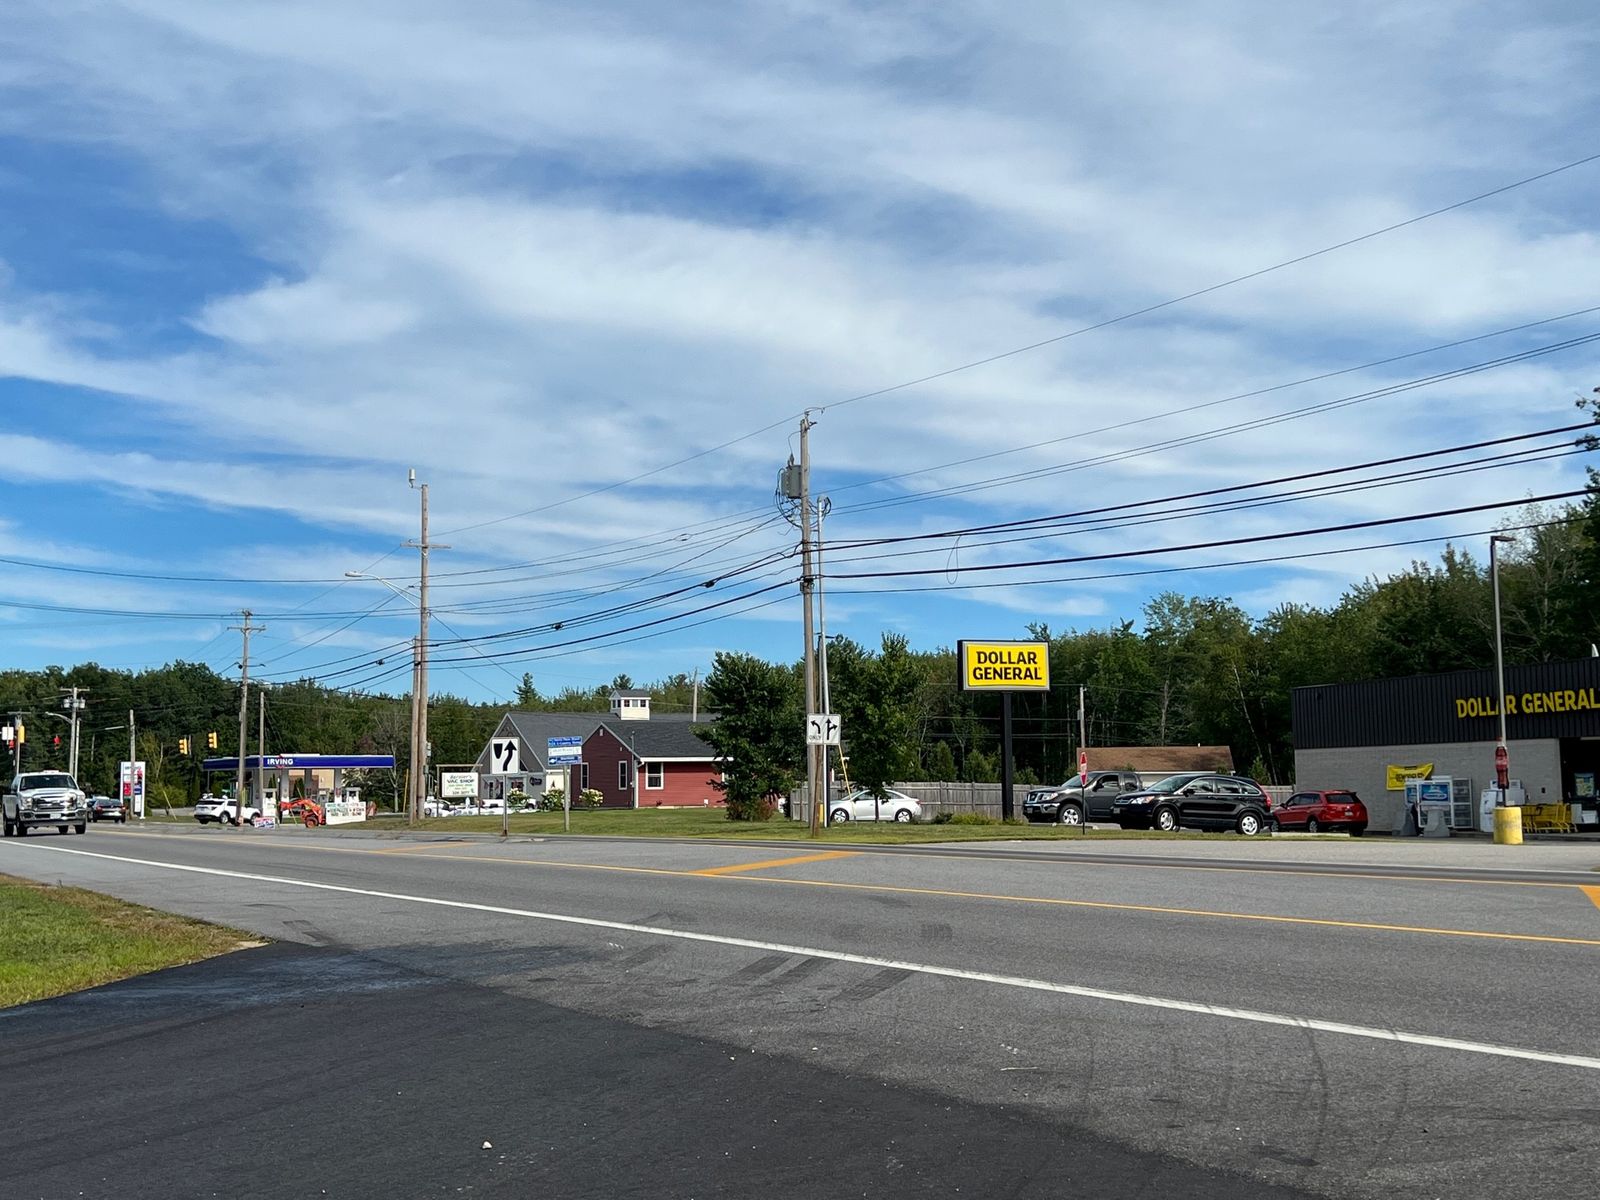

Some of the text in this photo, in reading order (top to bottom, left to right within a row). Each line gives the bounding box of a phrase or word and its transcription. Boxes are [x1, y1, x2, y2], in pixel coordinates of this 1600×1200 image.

[976, 651, 1037, 665] DOLLAR
[972, 666, 1042, 680] GENERAL
[1521, 688, 1600, 713] GENERAL
